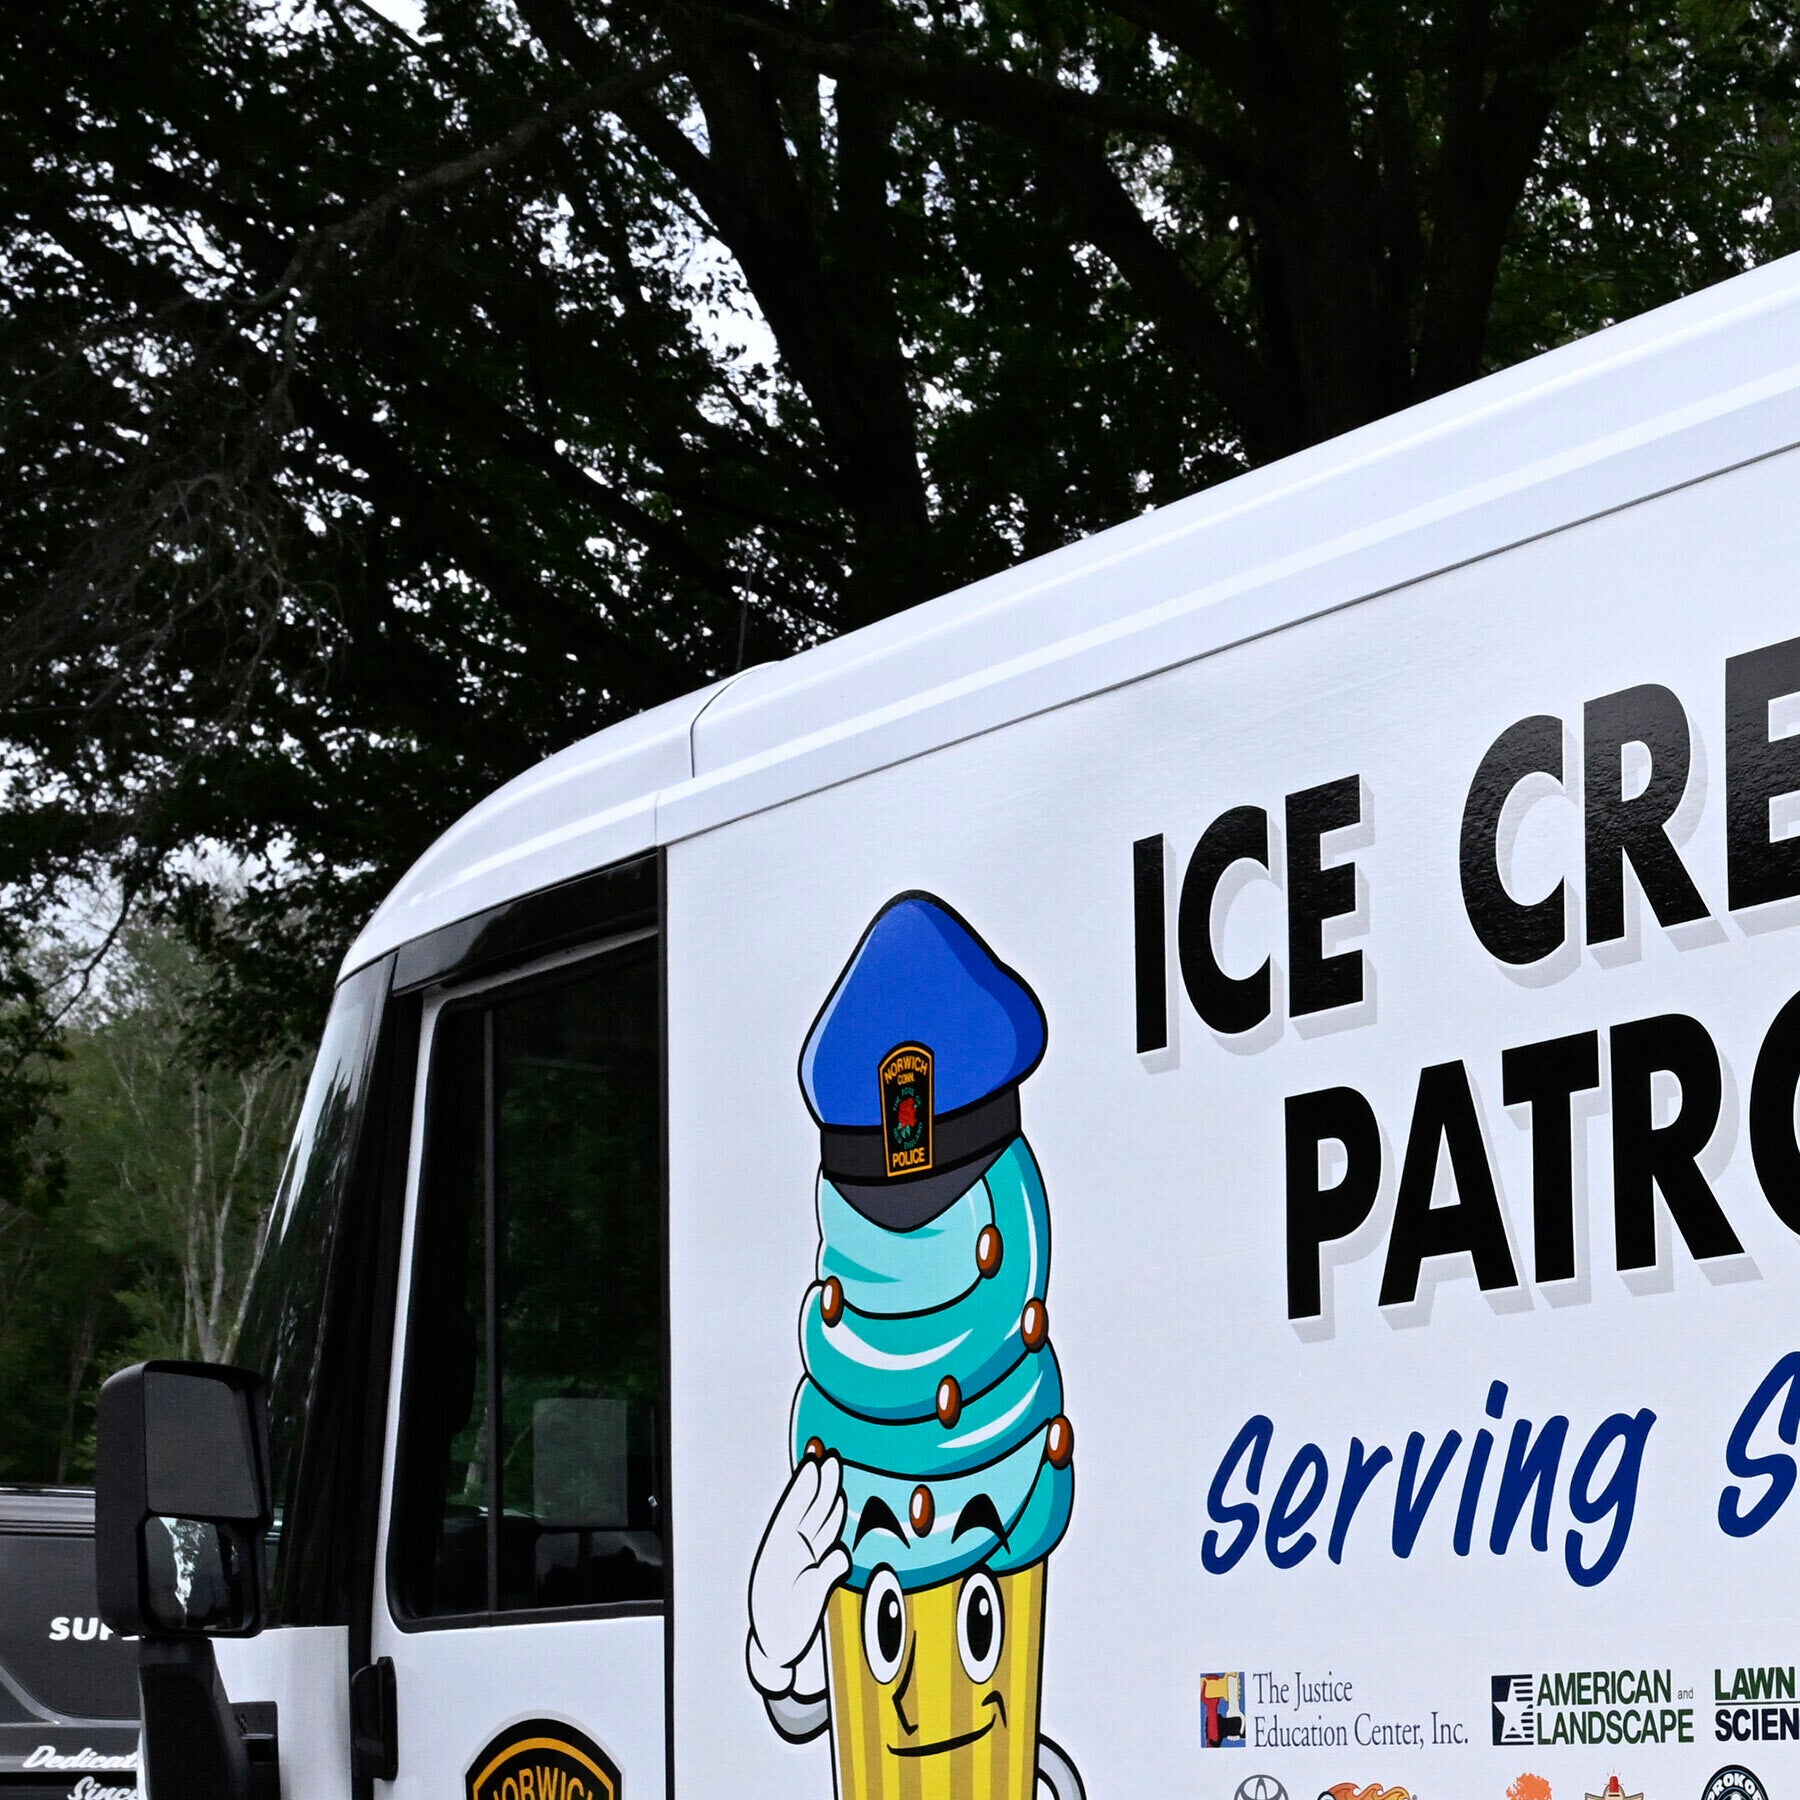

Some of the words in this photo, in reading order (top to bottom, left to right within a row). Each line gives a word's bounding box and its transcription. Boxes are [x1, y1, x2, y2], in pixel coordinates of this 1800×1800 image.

[1133, 774, 1368, 1054] ICE
[884, 1055, 928, 1084] NORWICH
[892, 1147, 925, 1168] POLICE
[1253, 1672, 1290, 1705] The
[1294, 1671, 1353, 1711] Justice
[1537, 1669, 1671, 1706] AMERICAN
[1677, 1687, 1694, 1700] and
[1714, 1666, 1796, 1701] LAWN
[1254, 1716, 1348, 1748] Education
[1354, 1713, 1425, 1749] Center,
[1431, 1711, 1469, 1745] Inc.
[1537, 1709, 1695, 1745] LANDSCAPE
